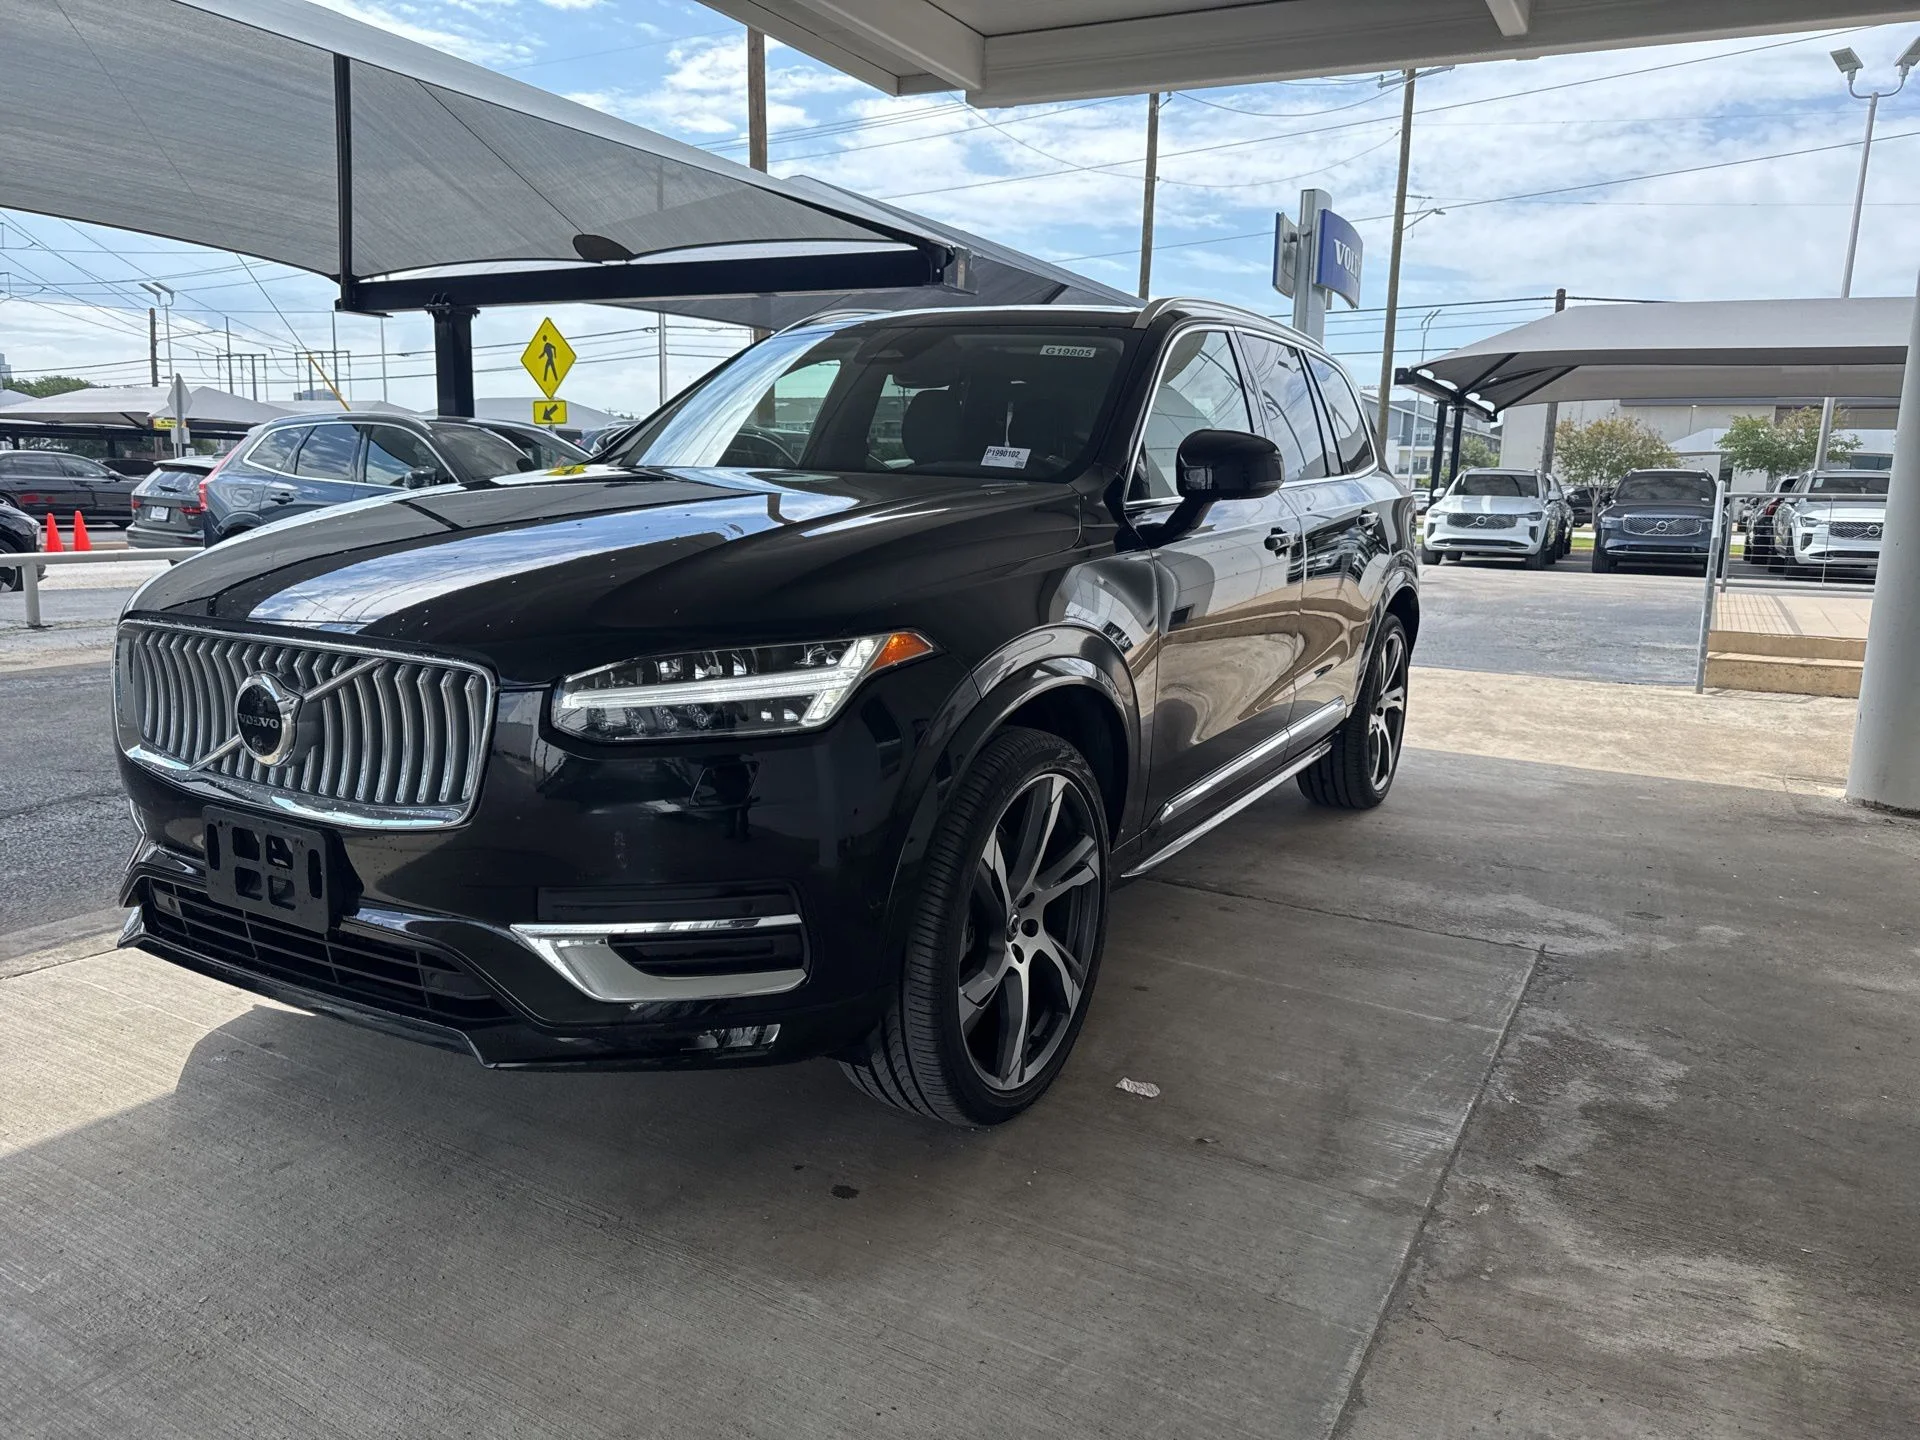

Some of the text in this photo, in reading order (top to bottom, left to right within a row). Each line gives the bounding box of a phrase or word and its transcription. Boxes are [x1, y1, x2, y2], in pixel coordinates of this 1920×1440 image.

[1045, 347, 1092, 357] G19805
[986, 448, 1021, 458] P1990102
[238, 712, 279, 729] VOLVO
